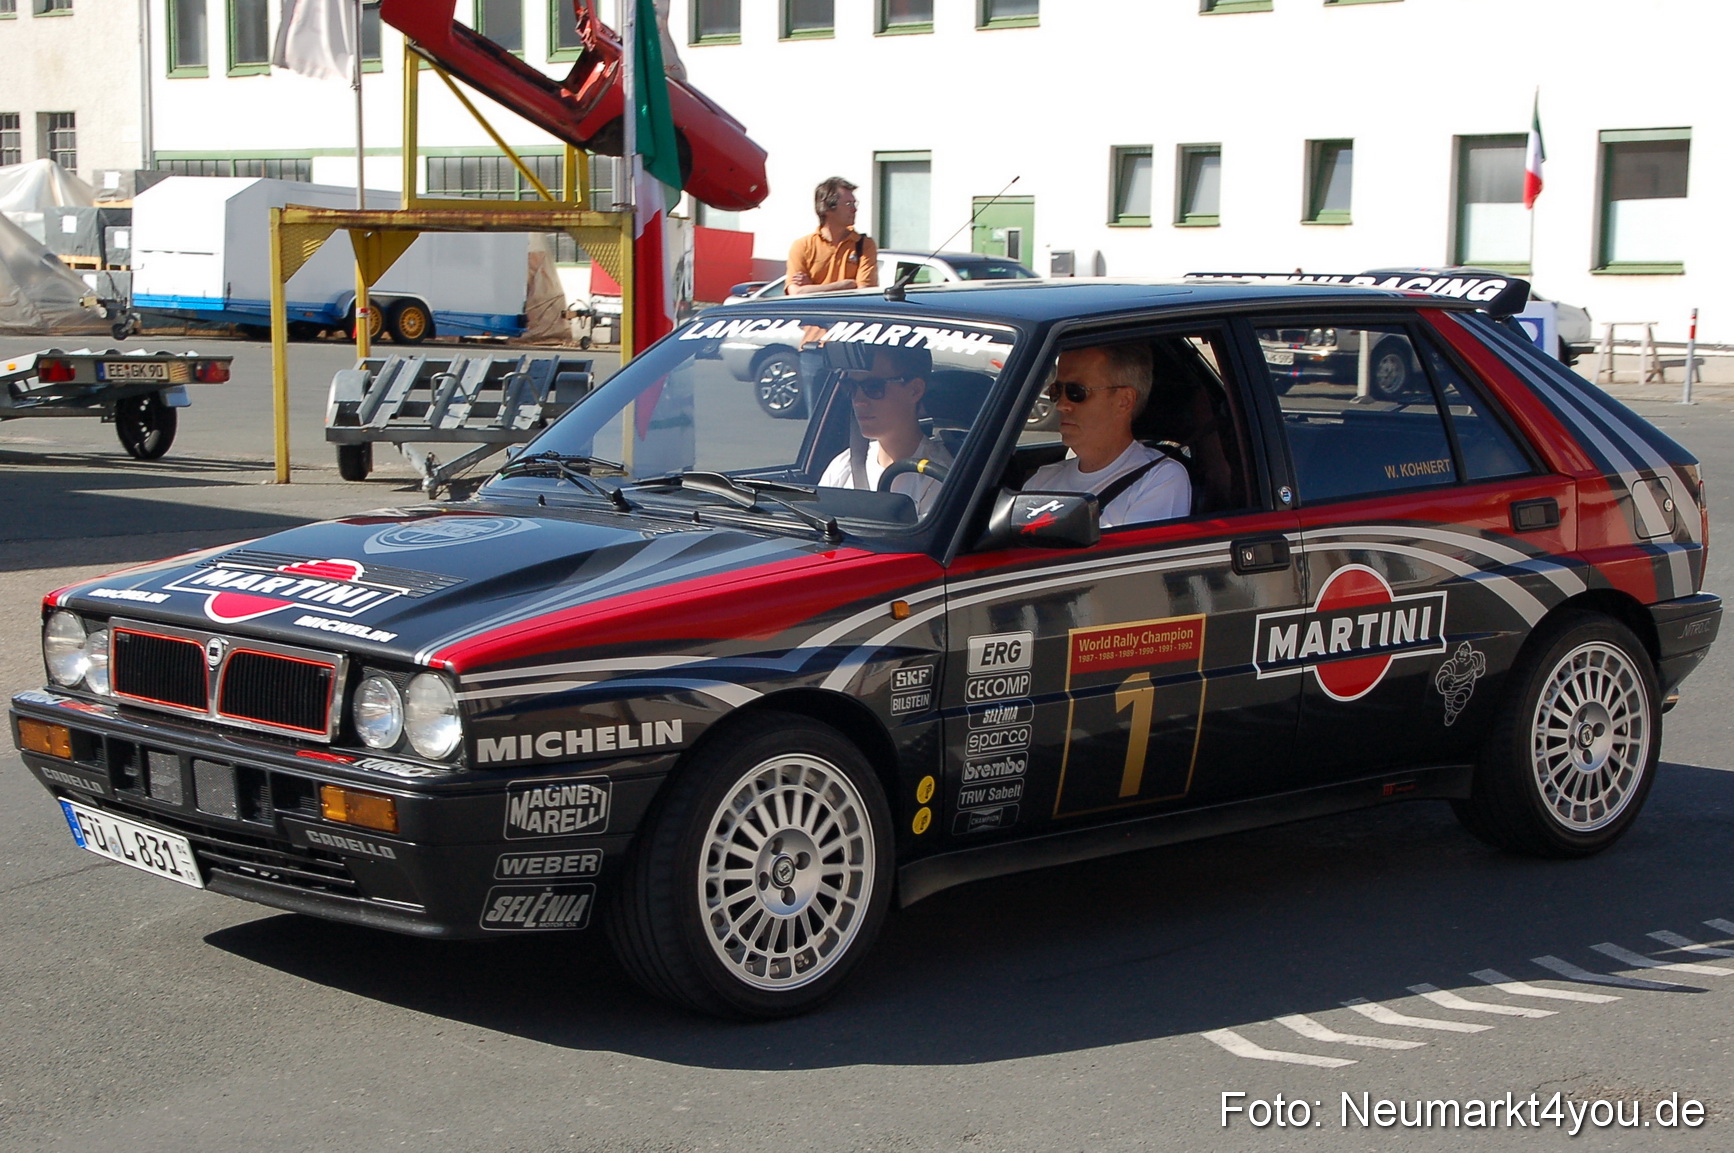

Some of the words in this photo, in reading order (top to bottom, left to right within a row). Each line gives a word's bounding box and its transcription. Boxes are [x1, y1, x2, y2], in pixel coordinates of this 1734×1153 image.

[679, 319, 801, 341] LANCIA
[821, 321, 996, 356] MARTINI
[109, 364, 125, 377] EE
[131, 364, 147, 377] GK
[149, 364, 163, 377] 90
[1384, 464, 1399, 479] W.
[1399, 458, 1451, 477] KOHNERT
[88, 588, 171, 605] MICHELIN
[191, 567, 384, 608] MARTINI
[294, 615, 398, 643] MICHELIN
[1079, 635, 1111, 652] World
[1113, 633, 1139, 649] Rally
[1141, 627, 1194, 645] Champion
[1267, 605, 1432, 664] MARTINI
[980, 639, 1022, 667] ERG
[1078, 655, 1094, 663] 1987
[1099, 651, 1115, 660] 1988
[1119, 649, 1135, 658] 1989
[1139, 647, 1154, 656] 1990
[1159, 644, 1173, 653] 1991
[1178, 641, 1193, 650] 1992
[895, 668, 929, 687] SKF
[967, 676, 1029, 699] CECOMP
[892, 693, 930, 711] BILSTEIN
[476, 719, 683, 763] MICHELIN
[968, 728, 1028, 751] sparco
[1115, 671, 1155, 798] 1
[964, 756, 1026, 780] brembo
[41, 767, 104, 794] CARELLO
[960, 789, 988, 804] TRW
[990, 784, 1021, 801] Sabelt
[76, 811, 110, 852] FÜ
[114, 824, 137, 862] L
[134, 831, 183, 877] 831
[305, 829, 397, 860] CARELLO
[502, 854, 598, 875] WEBER
